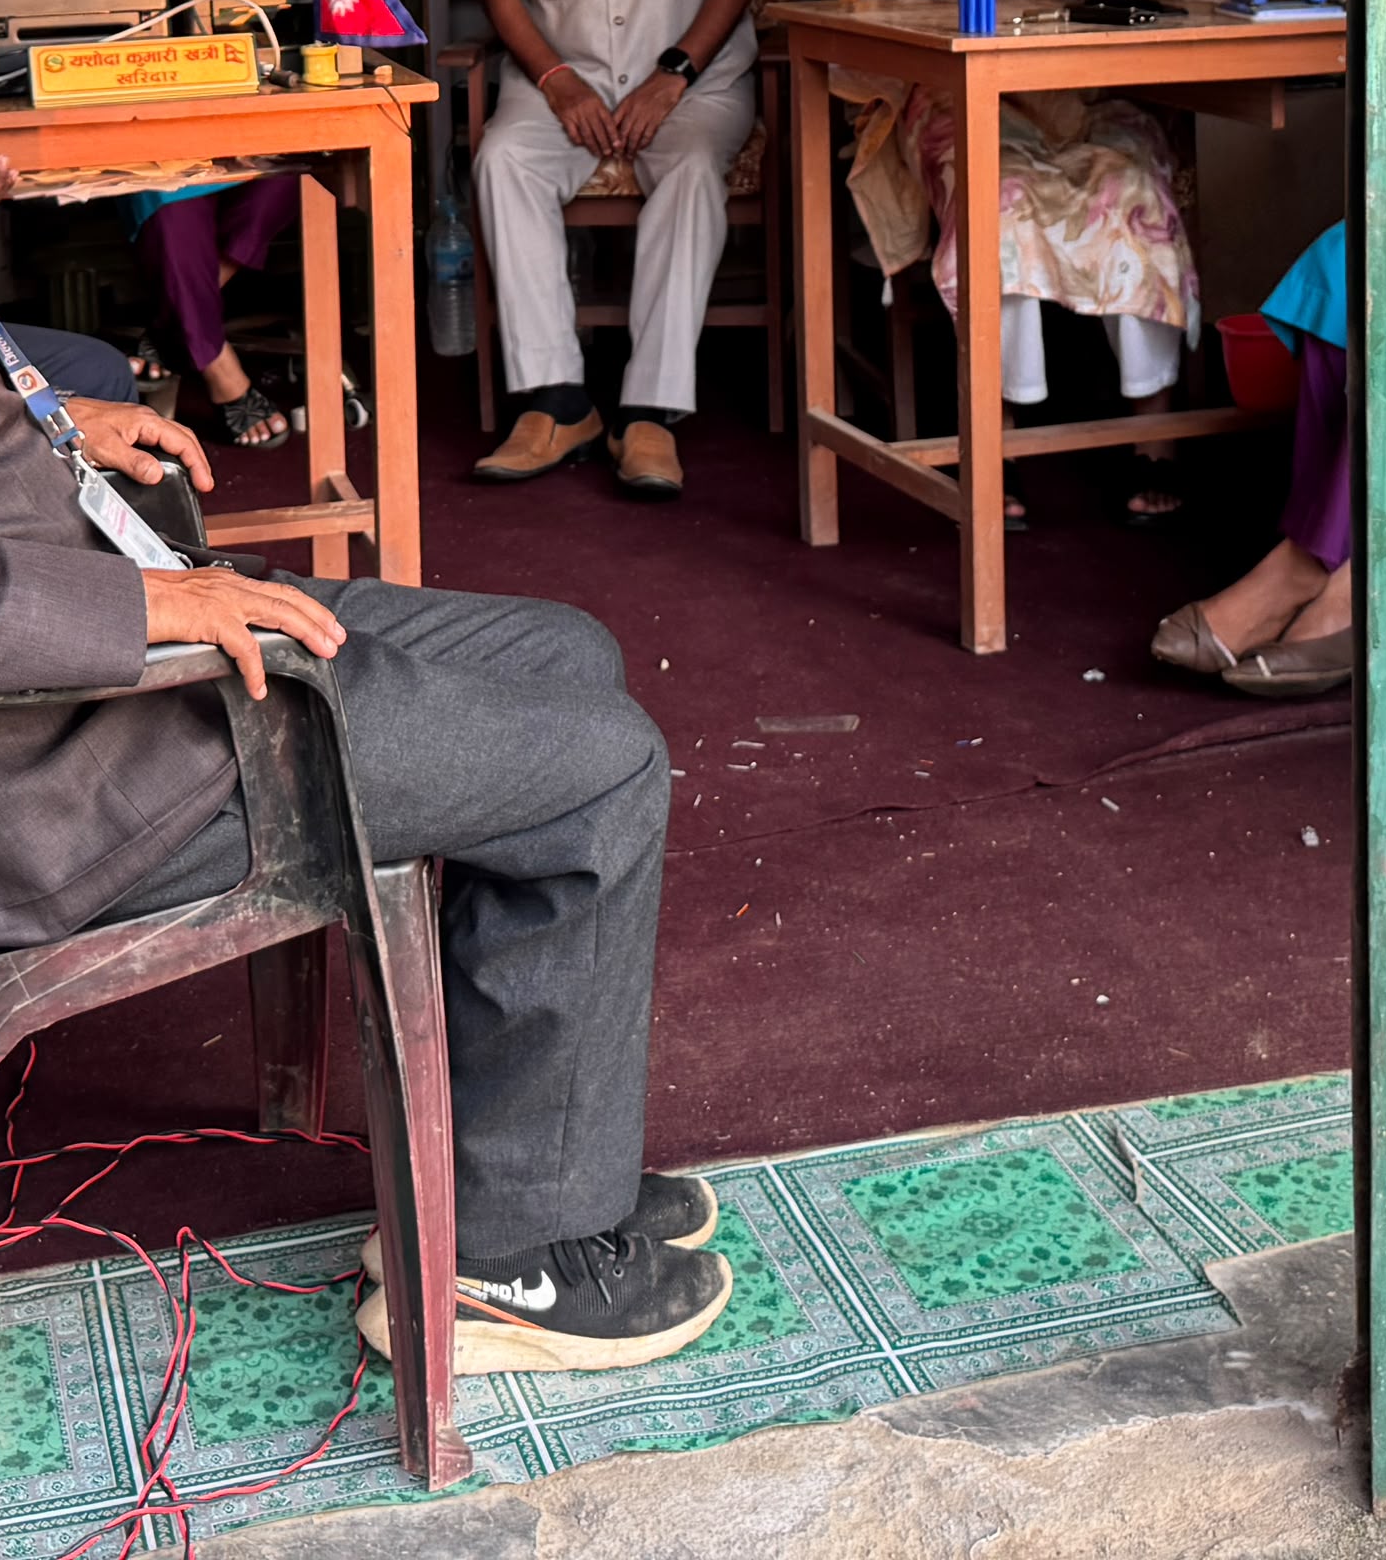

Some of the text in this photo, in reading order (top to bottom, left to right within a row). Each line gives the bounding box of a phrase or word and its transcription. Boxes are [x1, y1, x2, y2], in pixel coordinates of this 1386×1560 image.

[69, 43, 219, 68] यशोदा कुमारी खत्री
[115, 70, 180, 86] खरिदार
